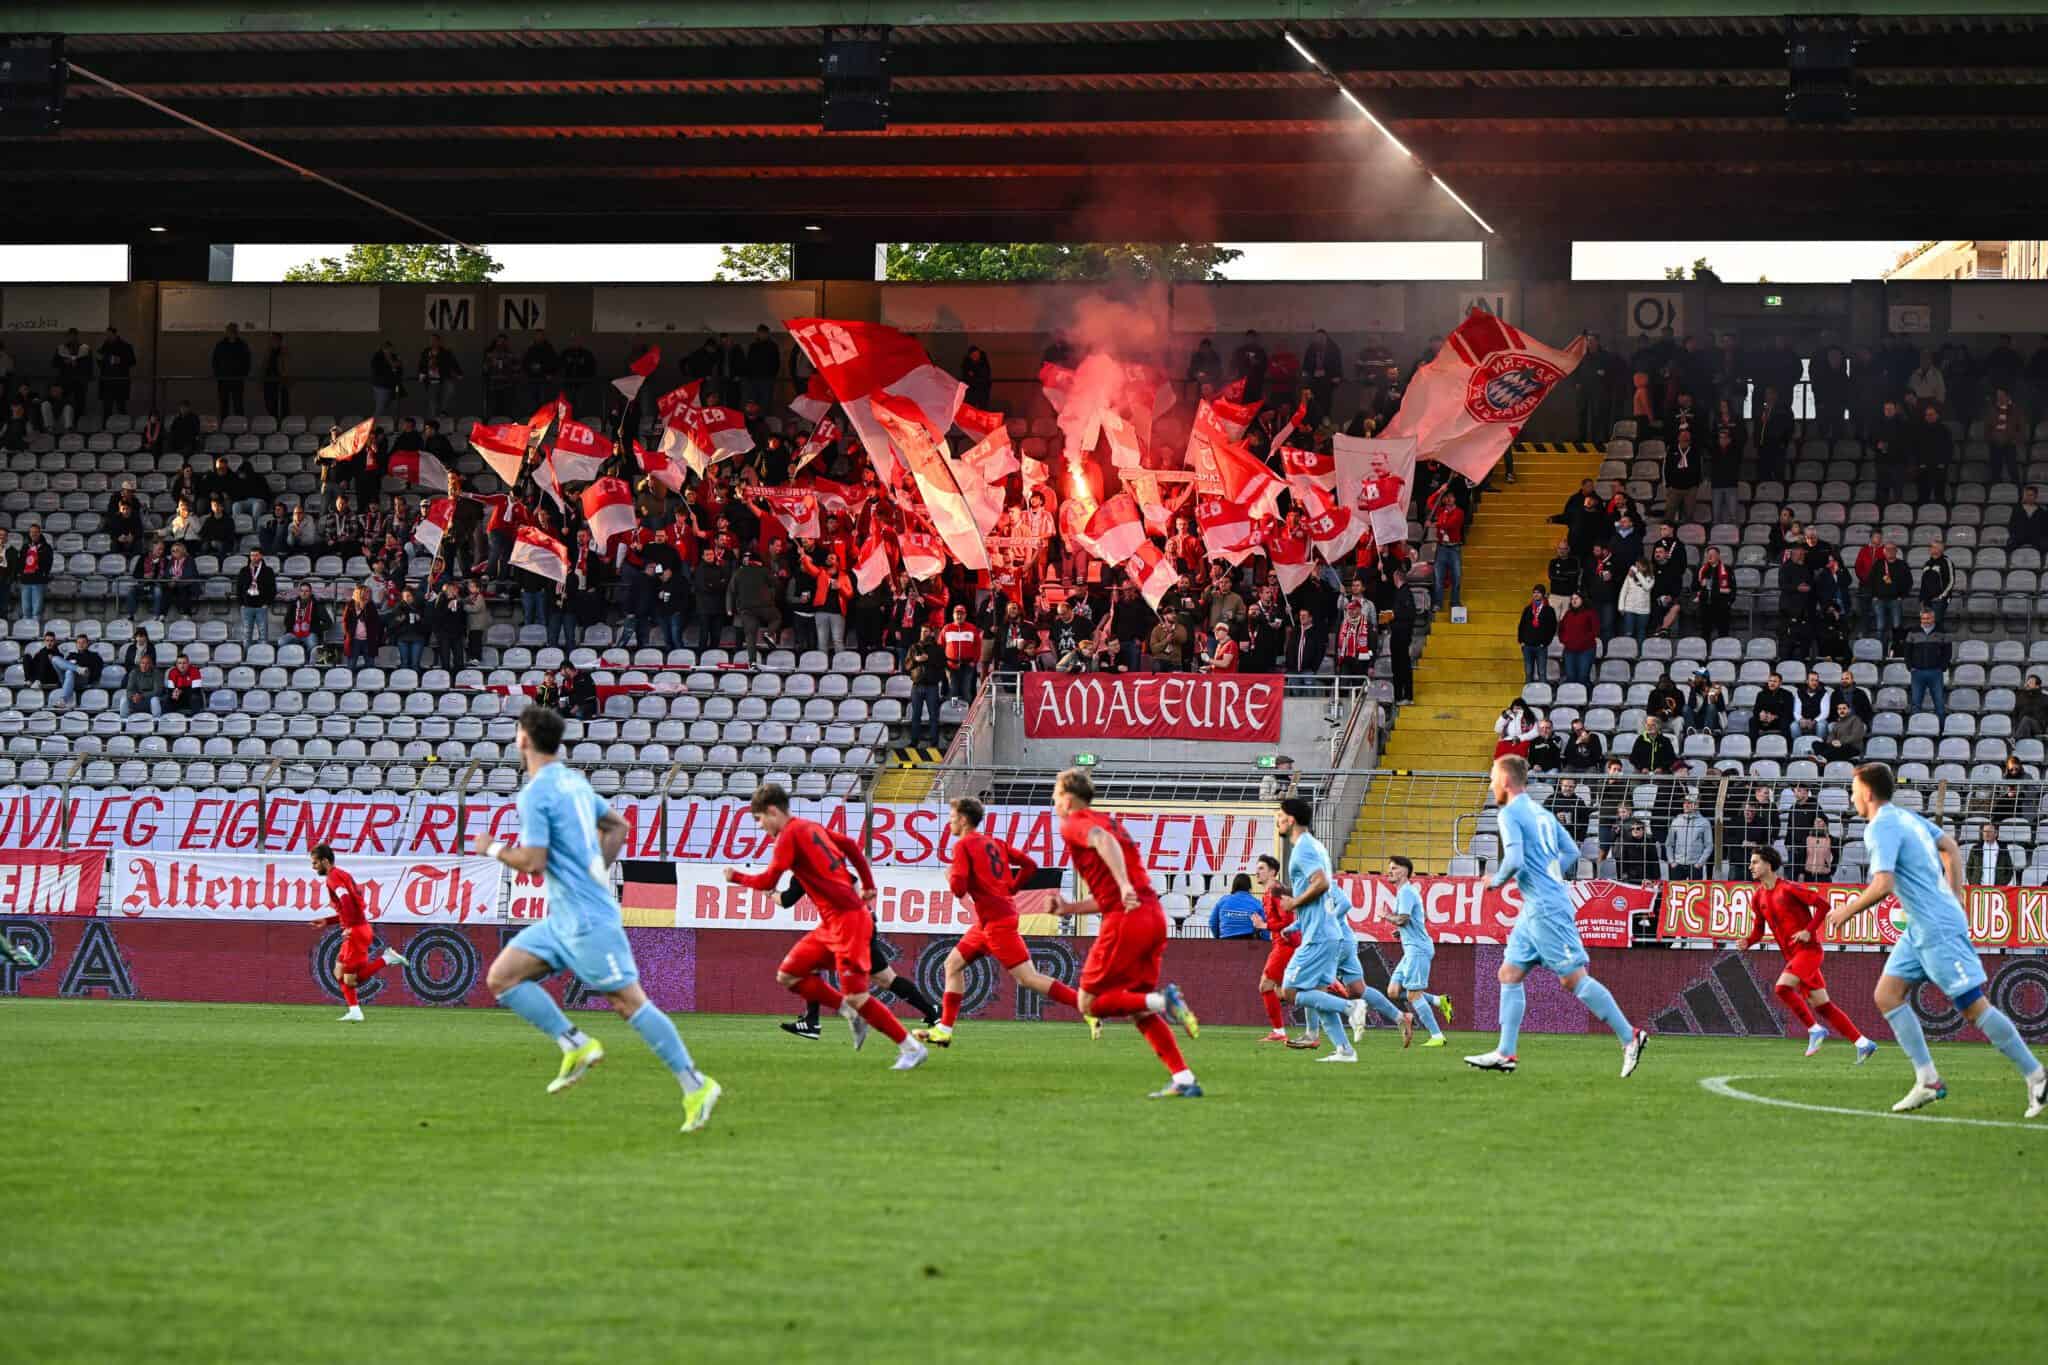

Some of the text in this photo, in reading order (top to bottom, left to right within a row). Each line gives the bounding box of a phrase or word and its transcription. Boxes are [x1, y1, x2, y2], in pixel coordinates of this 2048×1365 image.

[439, 299, 469, 330] M
[504, 299, 529, 330] N
[560, 423, 594, 444] FCB
[1281, 449, 1318, 467] FCB
[1032, 678, 1270, 733] AMATEURE
[0, 795, 164, 848] IVILEG
[178, 797, 400, 854] EIGENER
[984, 843, 1004, 879] 8
[695, 884, 776, 922] RED
[1669, 884, 1702, 930] FC
